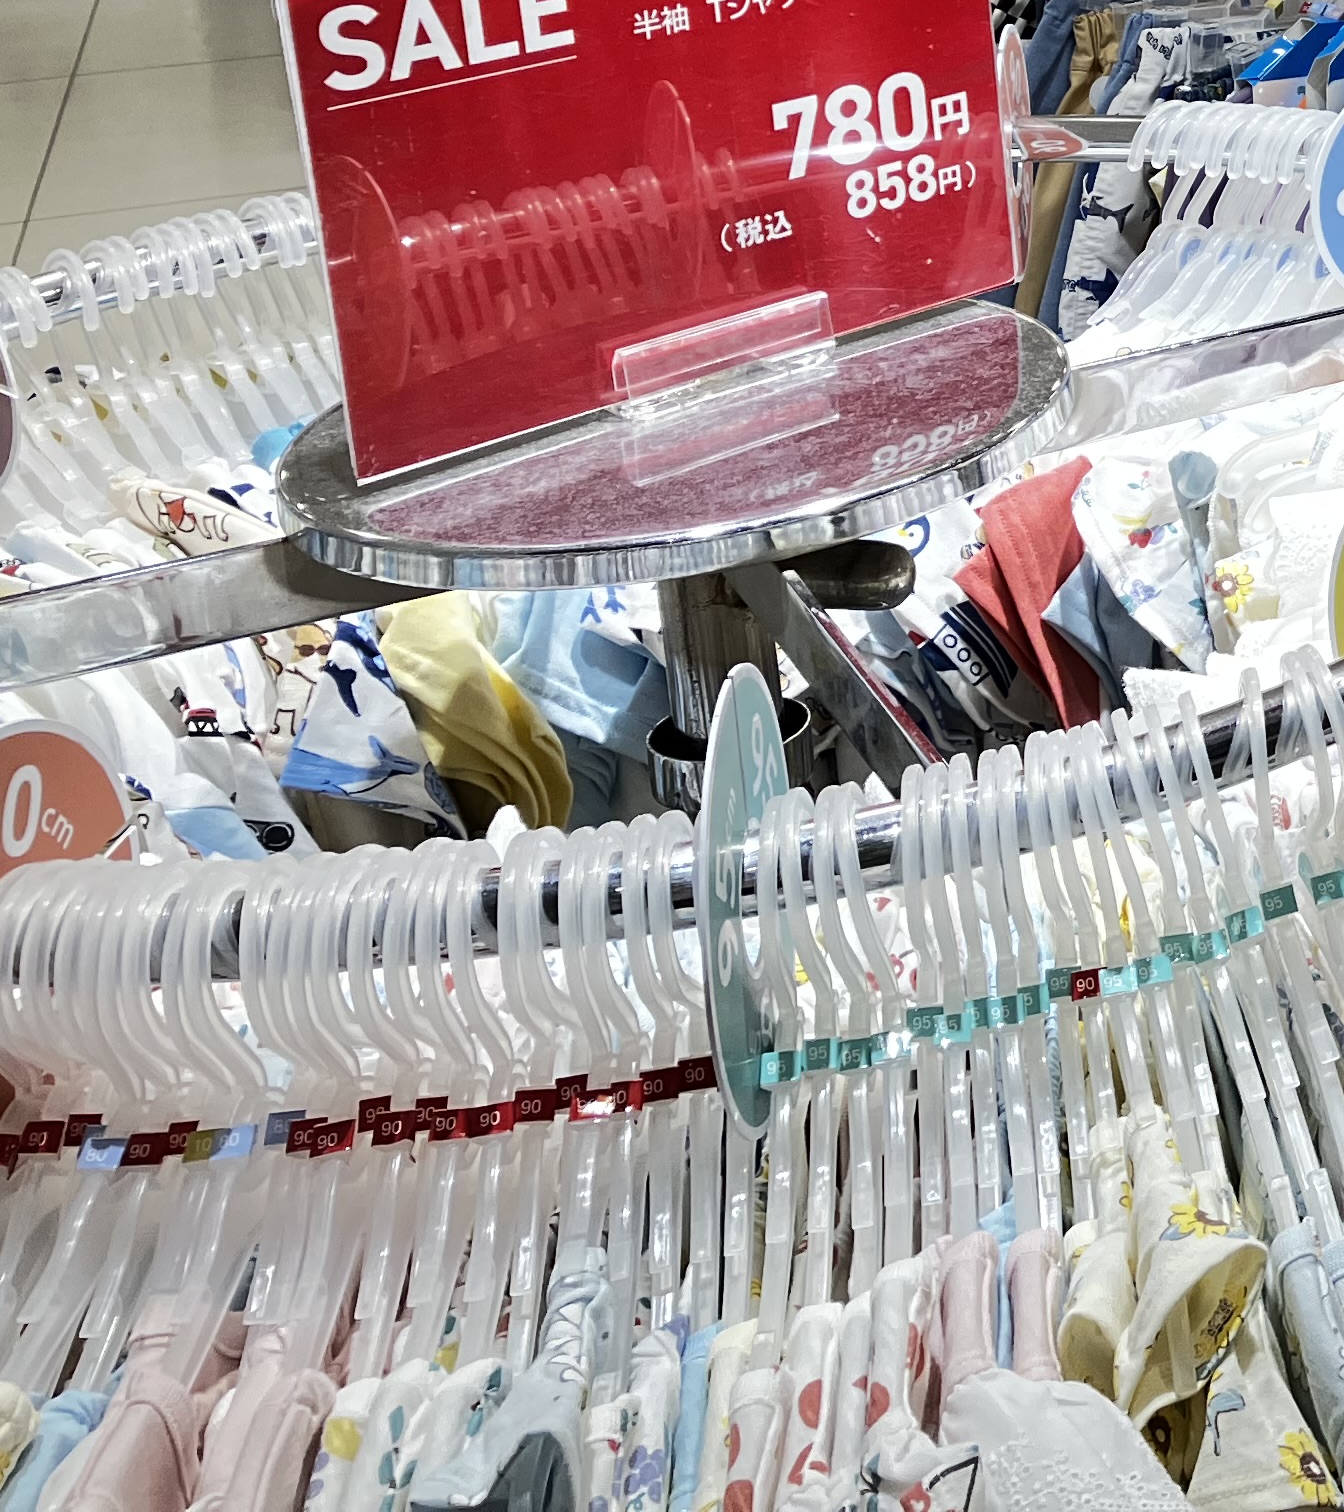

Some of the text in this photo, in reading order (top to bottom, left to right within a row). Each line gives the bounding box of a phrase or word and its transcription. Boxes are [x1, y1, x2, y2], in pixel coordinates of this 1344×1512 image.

[632, 6, 691, 39] 半袖
[772, 72, 971, 181] 780円
[845, 158, 977, 220] 858円)
[1318, 879, 1336, 894] 95
[1265, 896, 1283, 911] 95
[1165, 942, 1183, 958] 95
[1199, 941, 1215, 954] 95
[1050, 976, 1069, 990] 95
[1076, 978, 1095, 991] 90
[991, 1005, 1010, 1020] 95
[912, 1015, 931, 1030] 95
[808, 1045, 828, 1061] 95
[684, 1067, 705, 1083] 90
[767, 1061, 786, 1074] 95
[642, 1079, 663, 1095] 90
[520, 1100, 541, 1115] 90
[435, 1116, 456, 1131] 90
[479, 1111, 500, 1126] 90
[381, 1120, 402, 1136] 90
[28, 1131, 48, 1146] 90
[317, 1133, 338, 1150] 90
[85, 1148, 106, 1163] 80
[129, 1144, 150, 1158] 90
